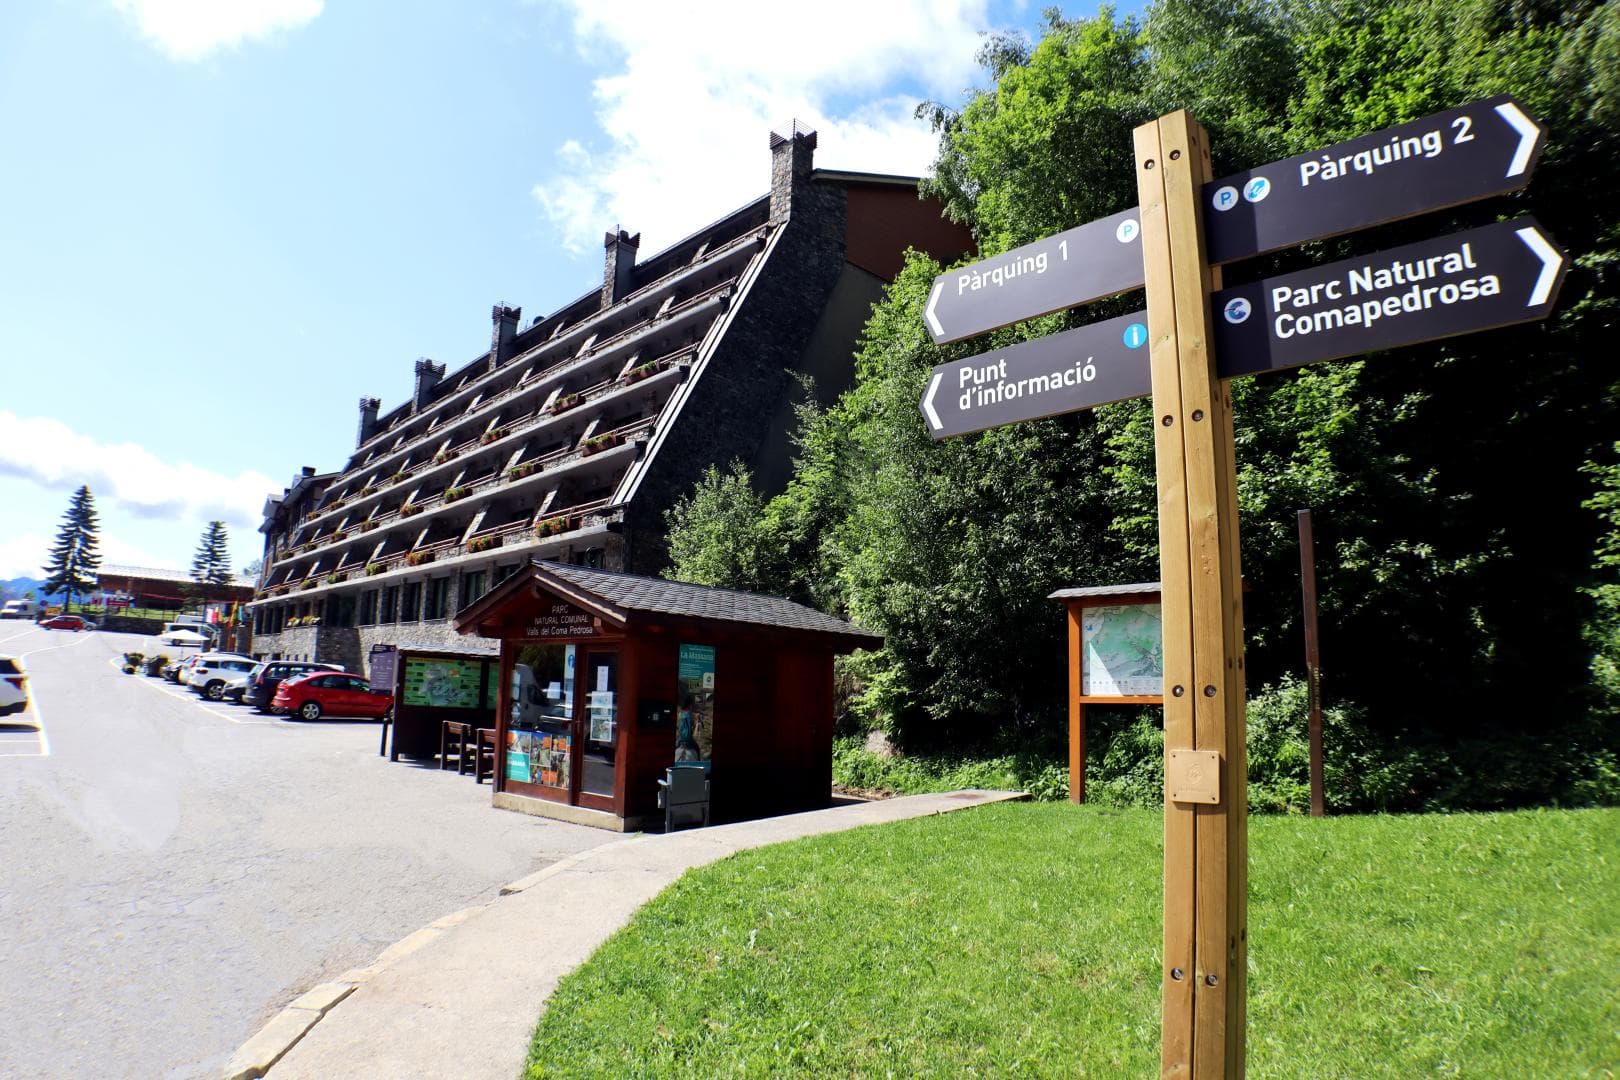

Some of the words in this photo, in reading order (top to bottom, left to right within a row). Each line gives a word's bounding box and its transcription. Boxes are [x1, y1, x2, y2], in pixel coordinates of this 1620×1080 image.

[1300, 129, 1443, 187] Pàrquing
[1451, 116, 1475, 145] 2
[958, 252, 1048, 296] Pàrquing
[1059, 240, 1068, 261] 1
[1272, 279, 1342, 312] Parc
[1348, 243, 1477, 295] Natural
[1274, 273, 1501, 339] Comapedrosa
[959, 358, 1007, 389] Punt
[959, 356, 1097, 410] d'informació
[534, 616, 559, 626] NATURAL
[560, 614, 589, 624] COMUNAL
[550, 626, 568, 635] Coma
[569, 625, 593, 635] Pedrosa
[551, 604, 569, 614] PARC
